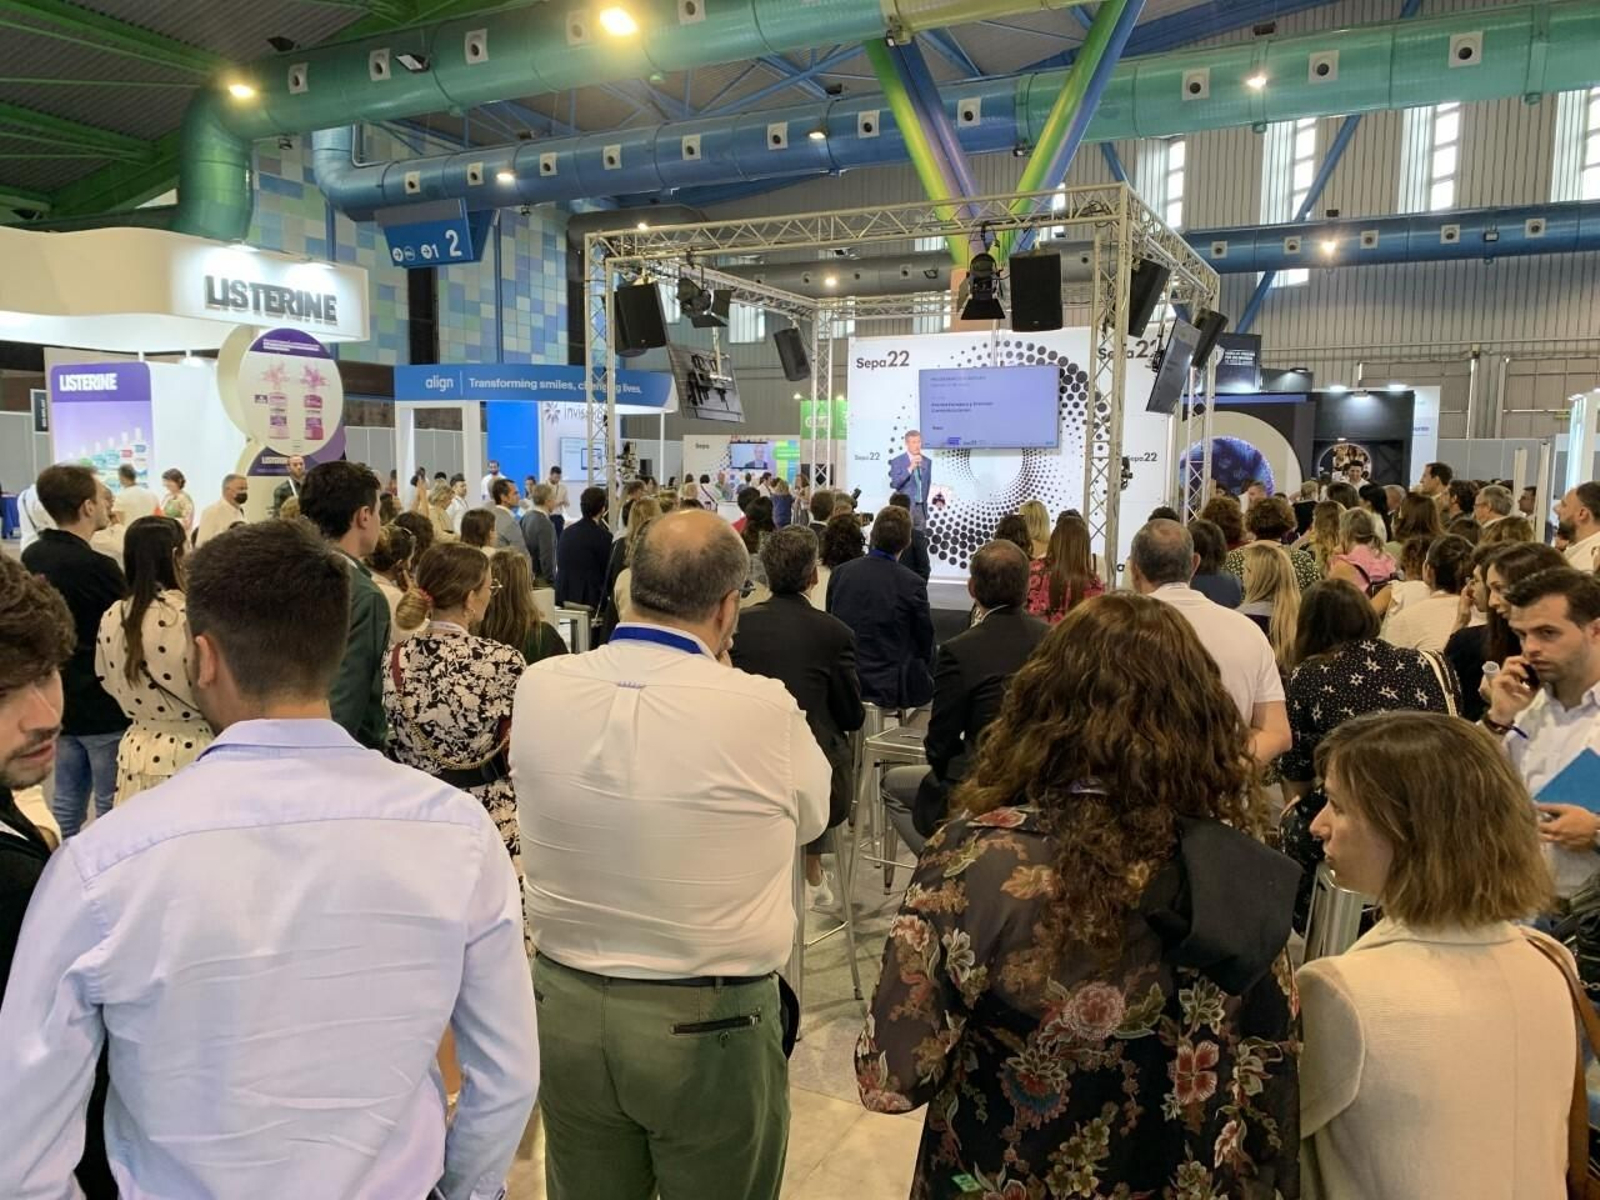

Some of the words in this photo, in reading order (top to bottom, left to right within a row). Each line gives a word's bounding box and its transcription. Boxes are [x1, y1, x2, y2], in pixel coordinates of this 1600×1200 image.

[431, 243, 440, 258] 1
[445, 229, 463, 257] 2
[204, 274, 338, 323] LISTERINE
[855, 350, 910, 371] Sepa22
[59, 372, 118, 392] LISTERINE
[425, 374, 454, 392] align
[469, 378, 538, 391] Transforming
[539, 379, 577, 392] smiles,
